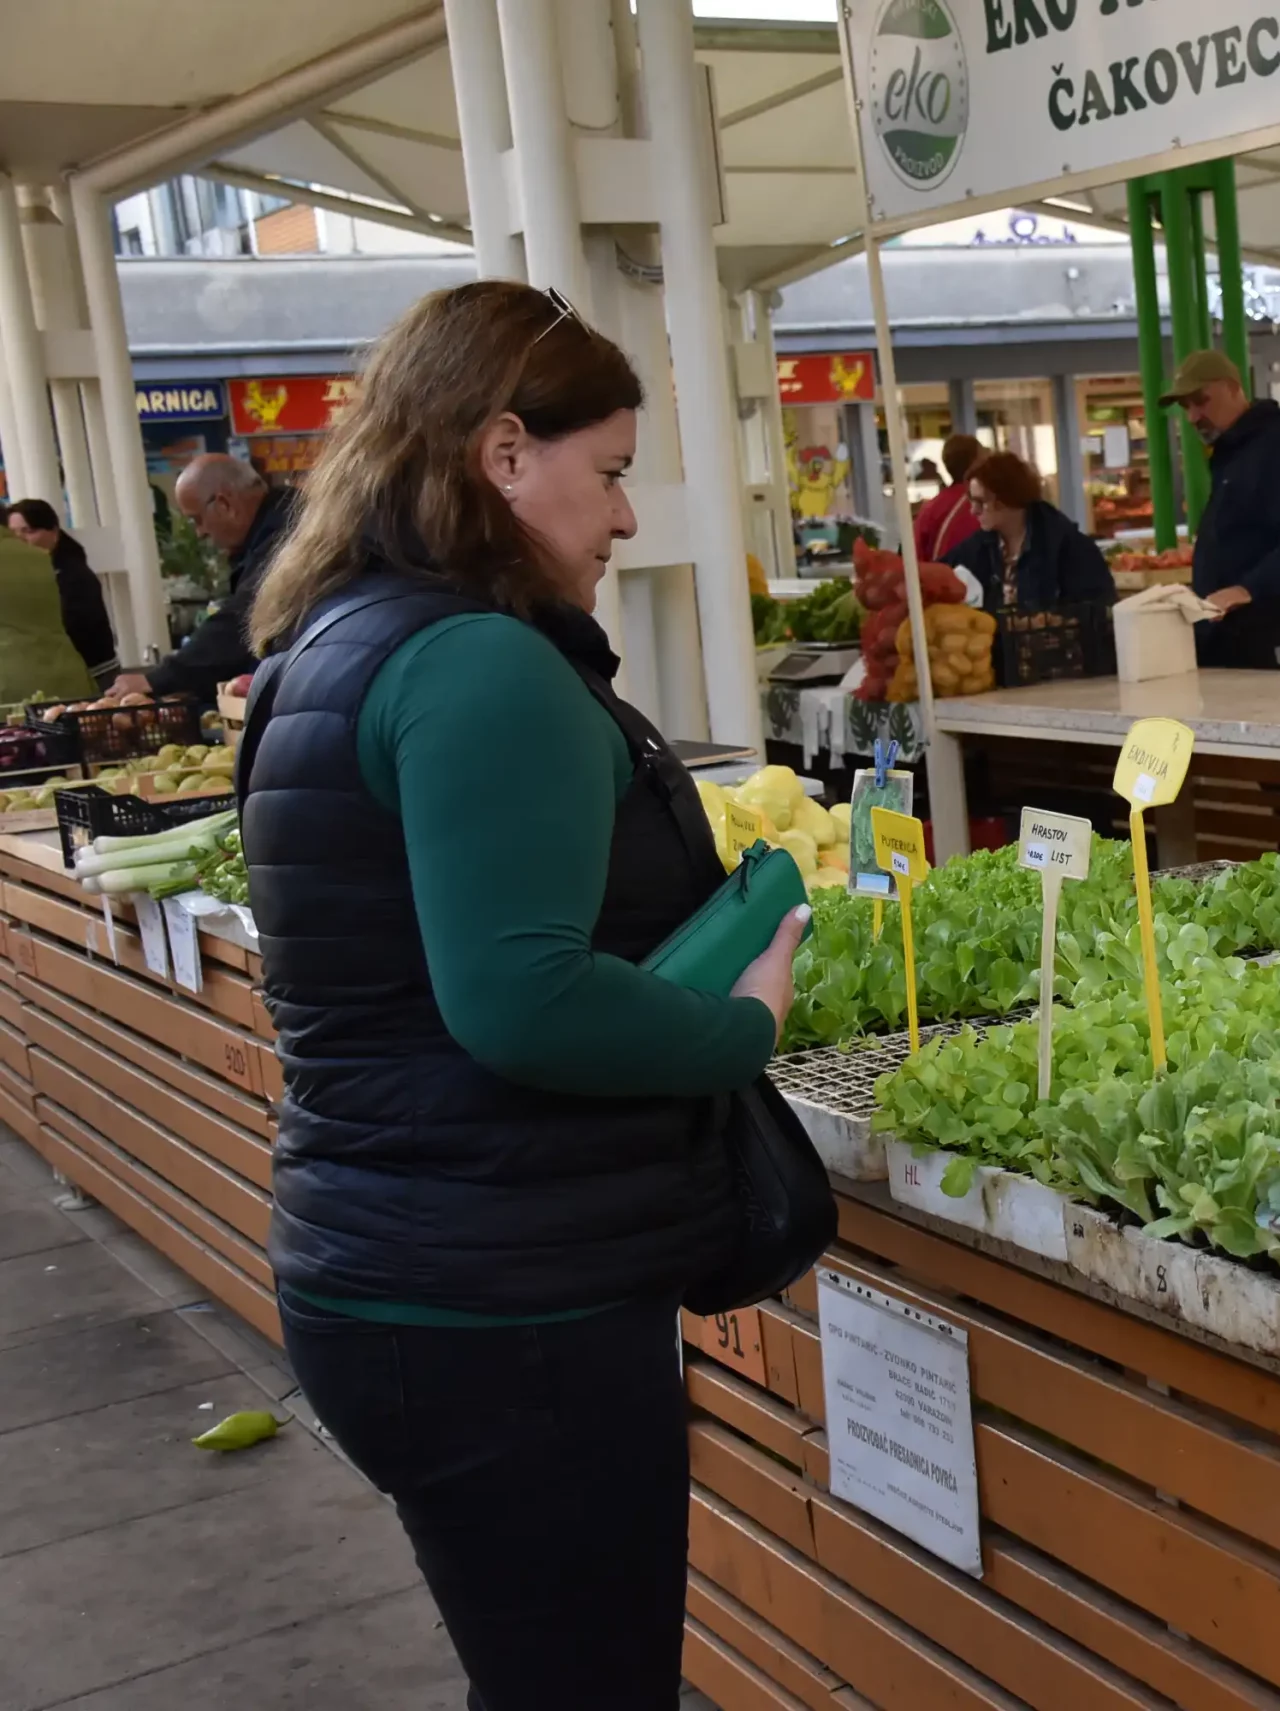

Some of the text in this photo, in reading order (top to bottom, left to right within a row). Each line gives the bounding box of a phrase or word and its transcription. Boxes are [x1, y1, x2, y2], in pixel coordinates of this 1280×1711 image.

[885, 45, 950, 124] eko
[1048, 17, 1280, 131] ČAKOVEC
[1127, 744, 1169, 779] ENDIVIJA
[881, 835, 918, 856] PUTERICA
[1031, 823, 1068, 842] HRASTOV
[1051, 849, 1073, 865] LIST
[905, 1164, 921, 1186] HL
[715, 1312, 745, 1359] 91
[884, 1349, 917, 1375] ZVONKO
[920, 1366, 957, 1394] PINTARIĆ
[914, 1382, 936, 1401] RADIĆ
[889, 1439, 930, 1480] PRESADNICA
[931, 1460, 958, 1495] POVRĆA
